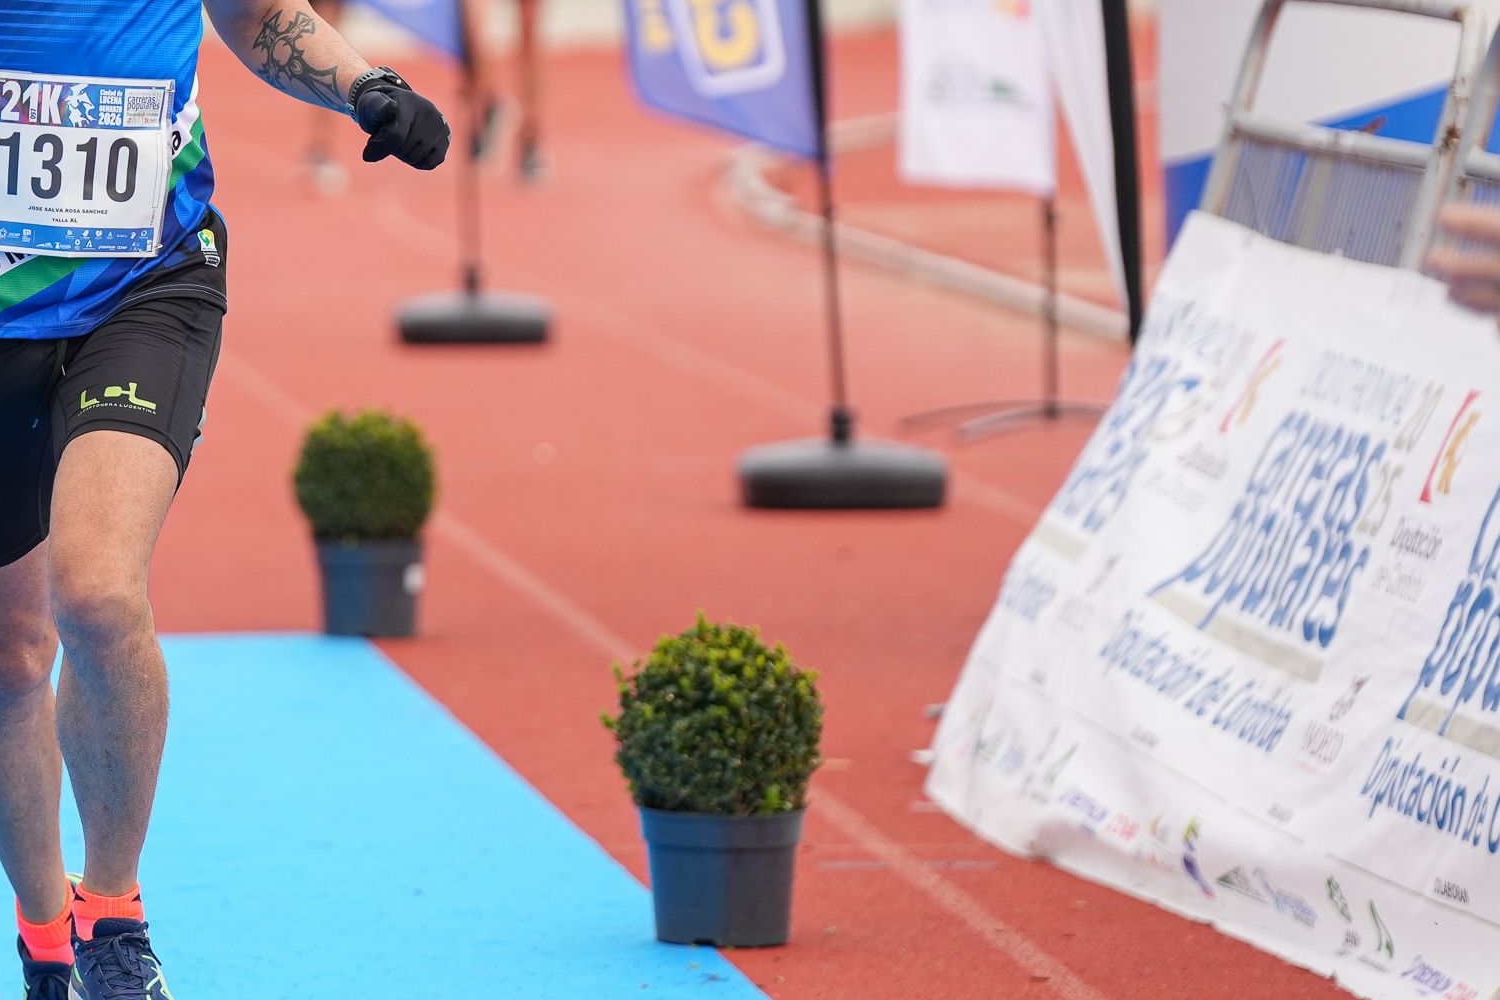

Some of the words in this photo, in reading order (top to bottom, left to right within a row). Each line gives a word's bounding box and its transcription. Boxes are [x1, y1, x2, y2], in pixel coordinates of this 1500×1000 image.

[0, 80, 63, 125] 21K
[98, 112, 122, 126] 2026
[126, 102, 160, 111] populares
[127, 96, 156, 104] carreras
[0, 131, 139, 203] 1310
[1145, 499, 1373, 650] populares
[1360, 735, 1470, 840] Diputación
